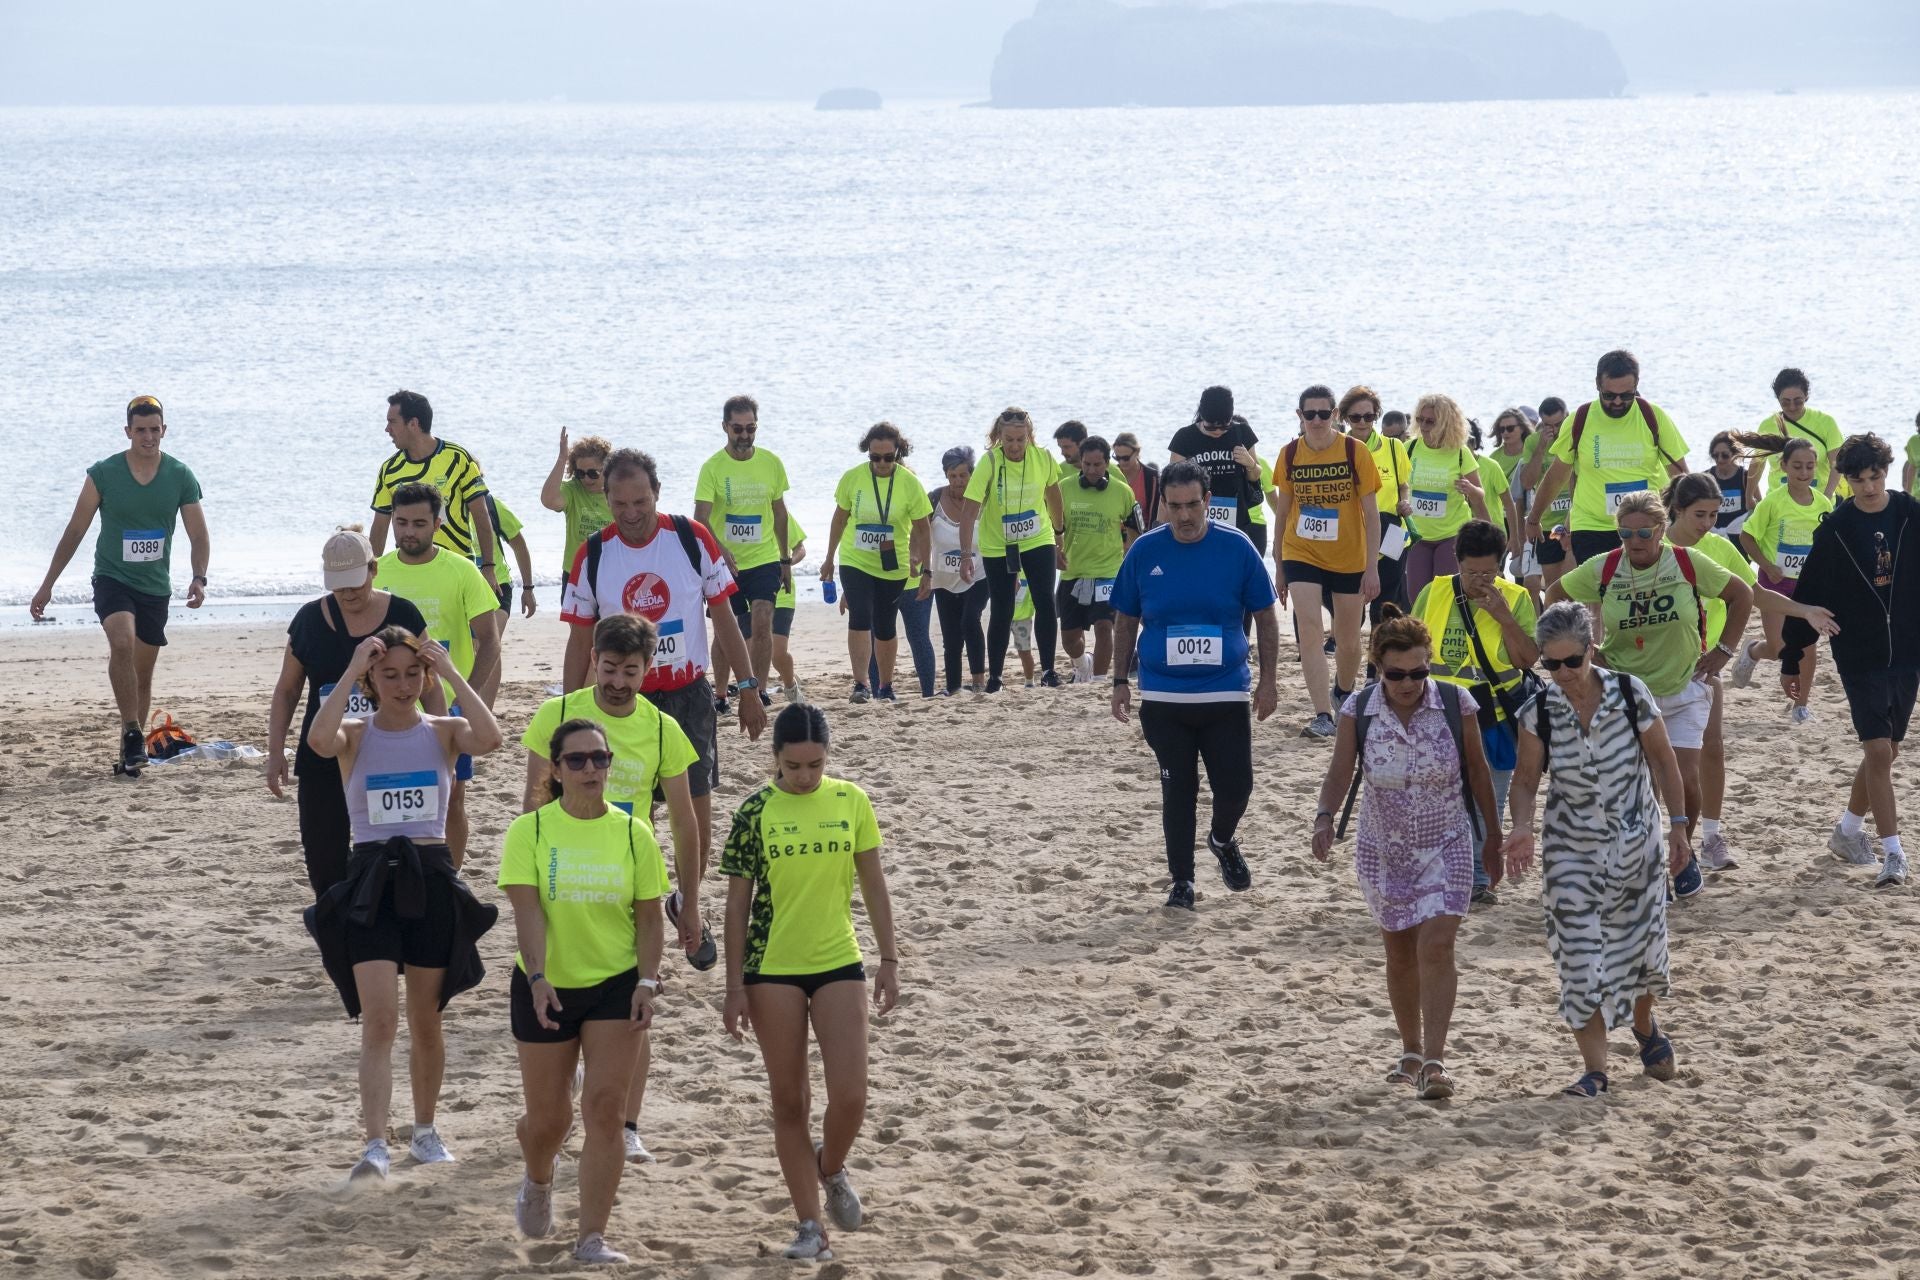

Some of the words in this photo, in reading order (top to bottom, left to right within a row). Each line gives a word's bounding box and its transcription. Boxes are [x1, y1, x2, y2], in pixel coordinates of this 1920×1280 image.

[1191, 450, 1234, 464] ROOKL
[1295, 484, 1312, 494] QUE
[1314, 481, 1352, 493] TENGO
[1416, 499, 1438, 511] 0631
[1721, 497, 1735, 507] 24
[732, 525, 754, 536] 0041
[1011, 519, 1034, 533] 0039
[1304, 517, 1328, 532] 0361
[862, 532, 886, 544] 0040
[131, 540, 159, 554] 0389
[945, 555, 961, 567] 087
[1785, 555, 1805, 568] 024
[640, 589, 653, 598] LA
[1102, 585, 1112, 596] 09
[1617, 592, 1632, 601] LA
[1635, 589, 1658, 600] ELA
[632, 594, 665, 609] MEDIA
[1629, 595, 1675, 617] NO
[1619, 611, 1679, 630] ESPERA
[653, 636, 675, 657] 40
[1178, 638, 1211, 655] 0012
[1442, 637, 1467, 647] ontr
[344, 695, 369, 713] 39
[382, 788, 424, 811] 0153
[768, 840, 851, 860] Bezana
[548, 847, 558, 901] Cantabria
